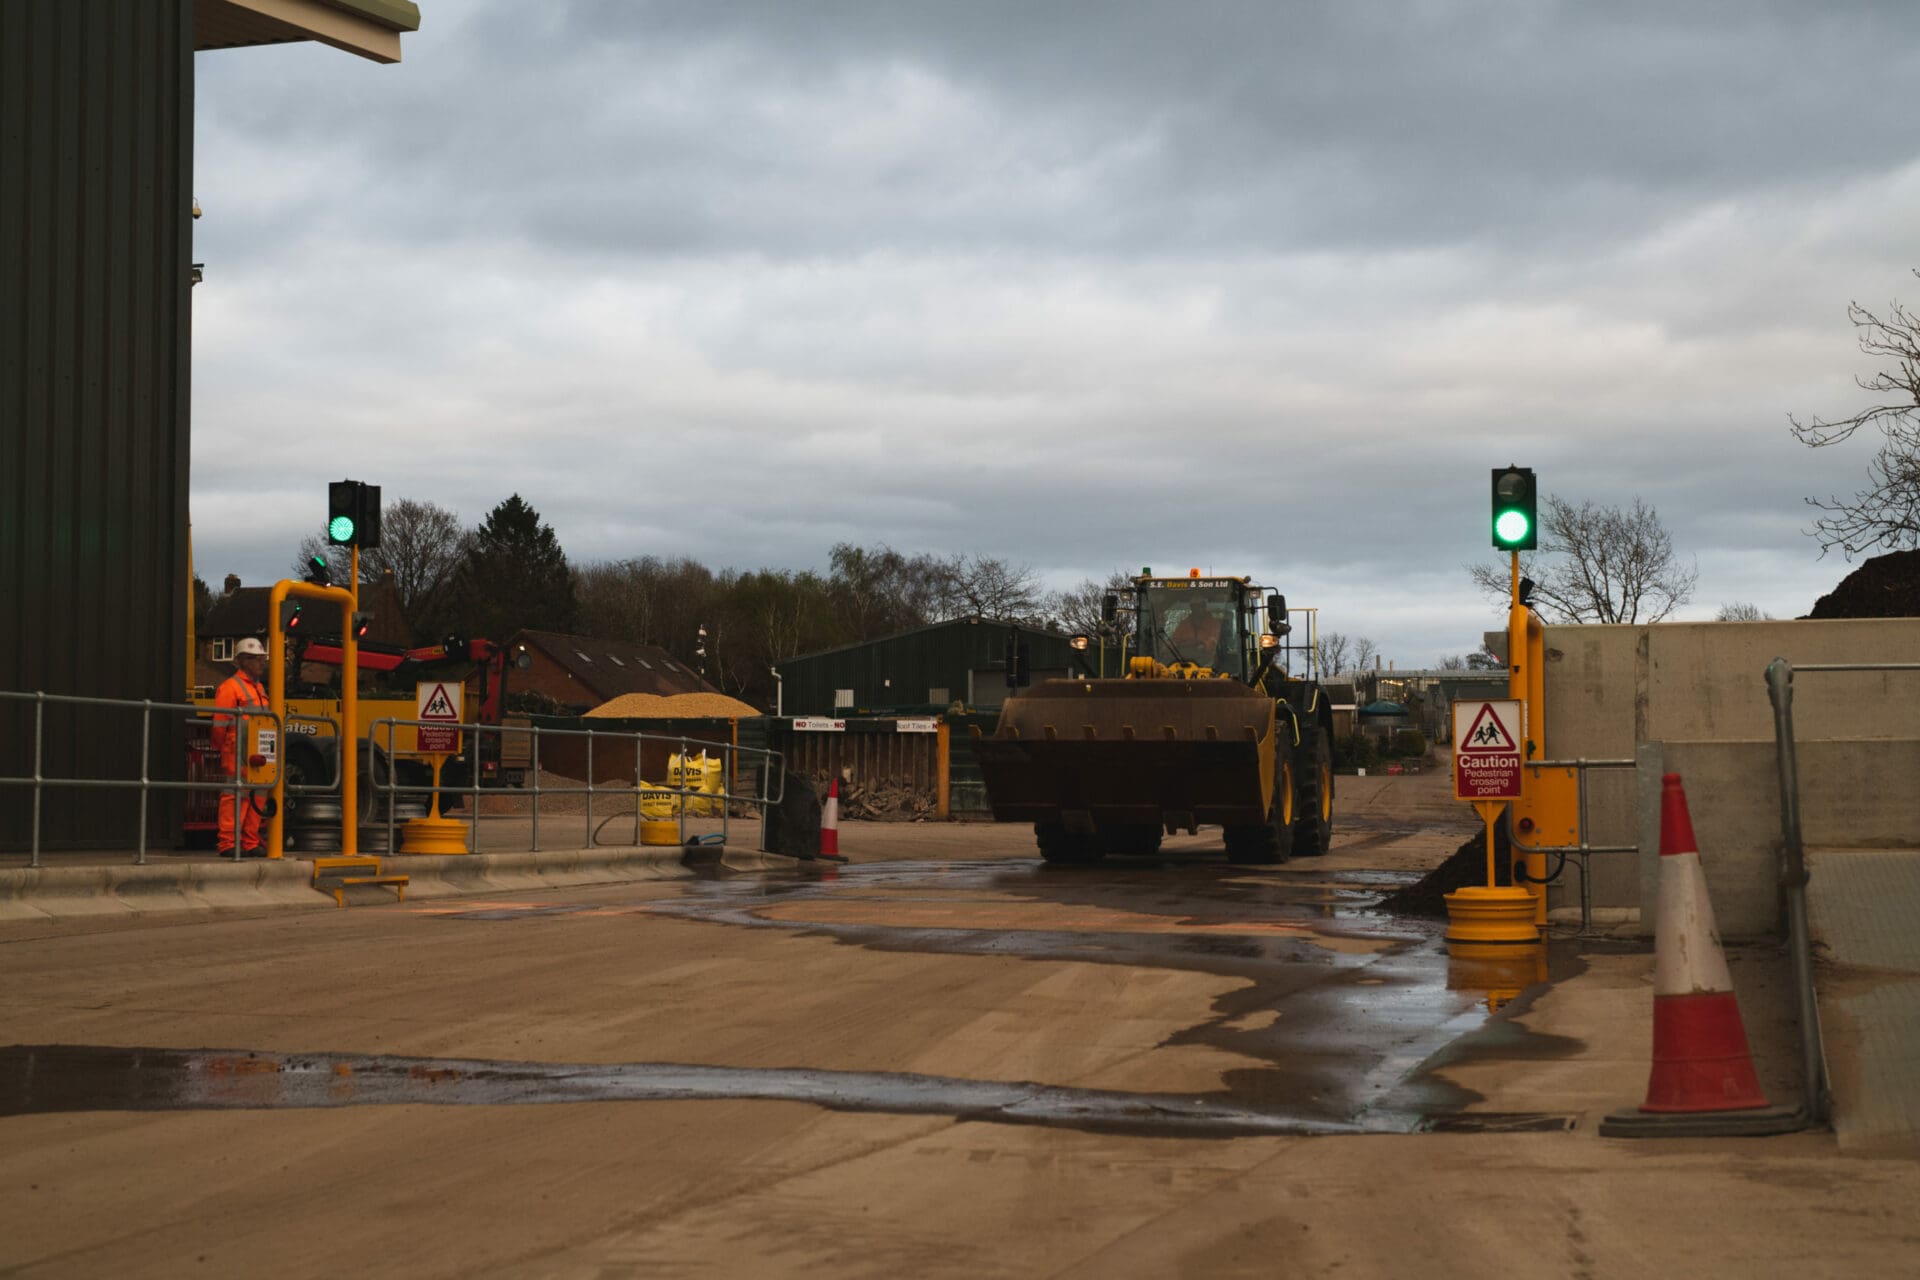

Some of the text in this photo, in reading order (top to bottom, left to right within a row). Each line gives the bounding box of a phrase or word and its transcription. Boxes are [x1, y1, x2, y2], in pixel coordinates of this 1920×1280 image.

[1215, 580, 1228, 588] Ltd
[795, 721, 806, 729] NO
[1459, 755, 1518, 768] Caution
[1464, 768, 1514, 778] Pedestrian
[1469, 778, 1509, 788] crossing
[1477, 785, 1501, 796] point
